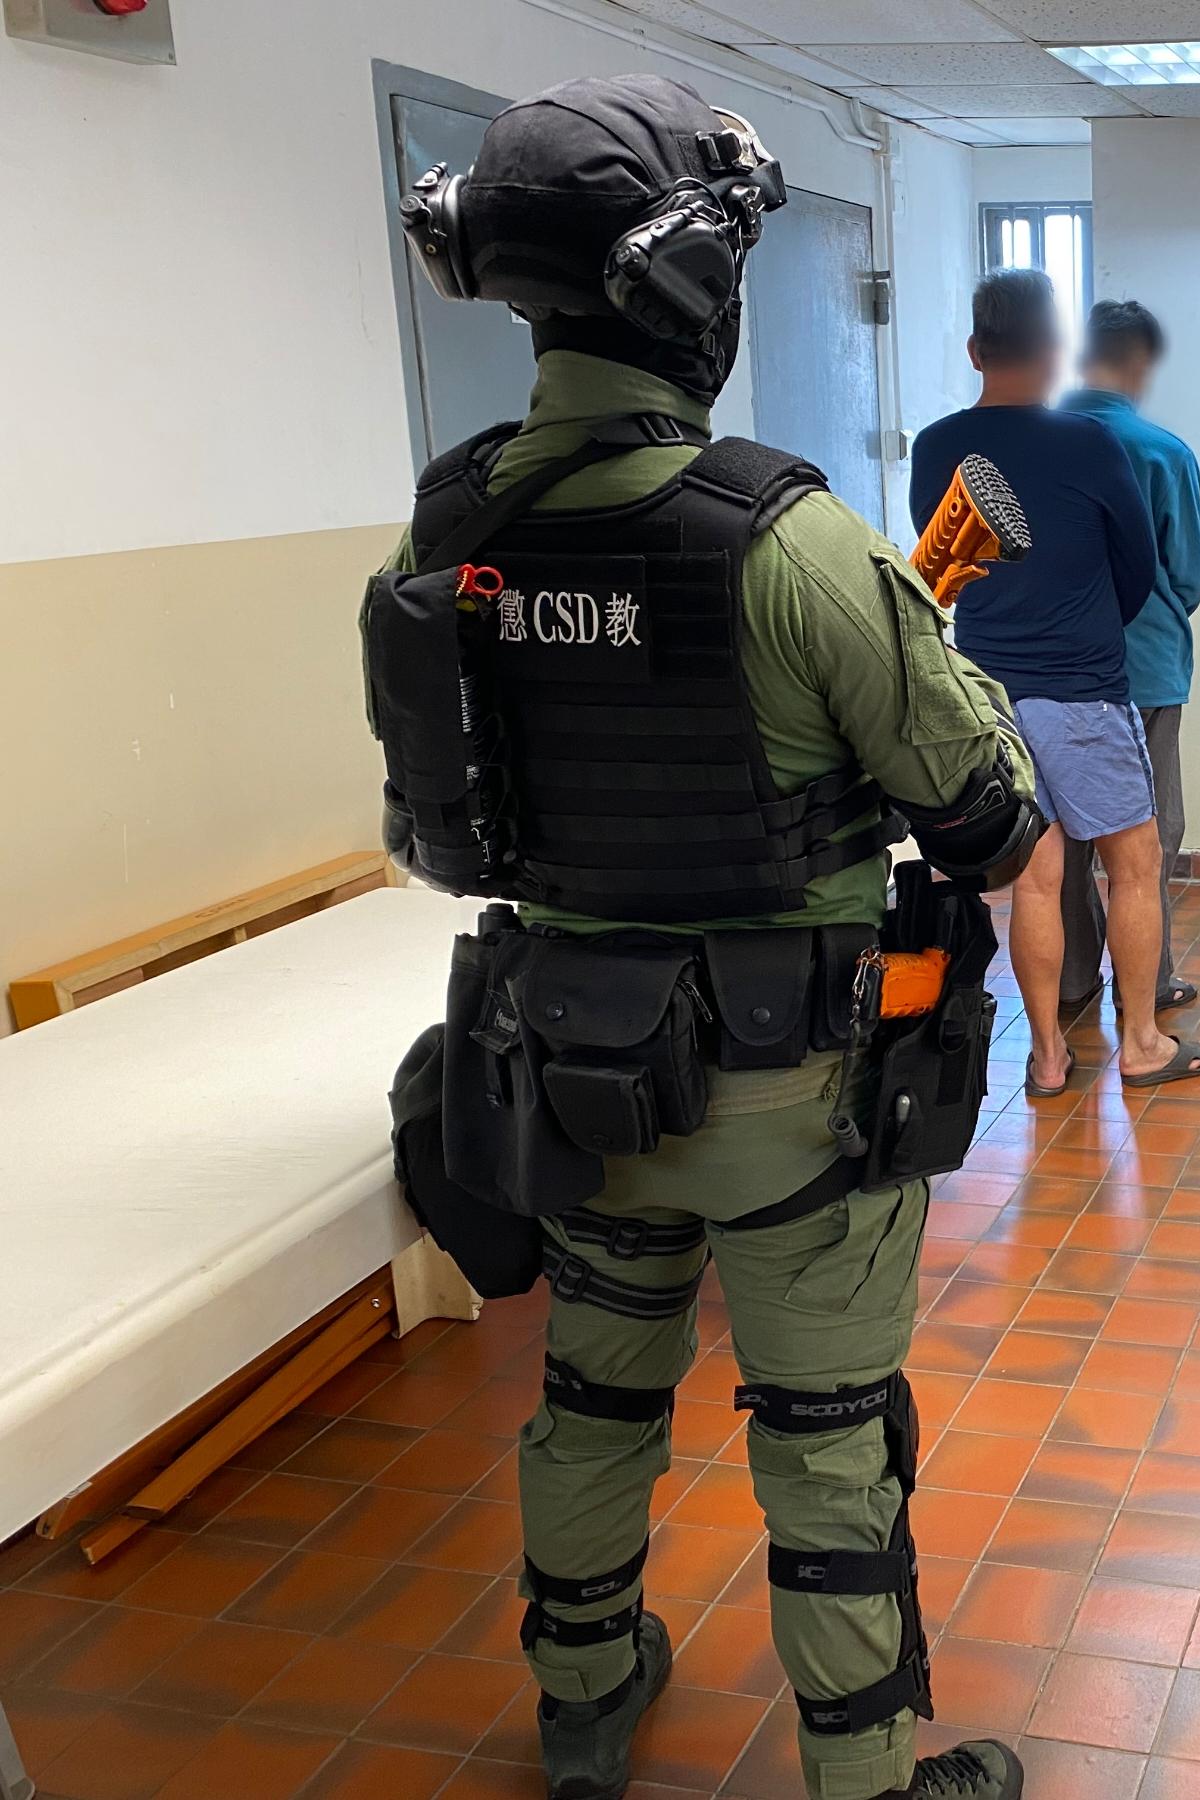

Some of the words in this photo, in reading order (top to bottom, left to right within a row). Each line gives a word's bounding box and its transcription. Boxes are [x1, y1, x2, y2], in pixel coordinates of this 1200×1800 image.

[497, 588, 528, 642] 懲
[533, 590, 599, 644] CSD
[605, 592, 642, 647] 教
[790, 1388, 887, 1416] SCOYCO
